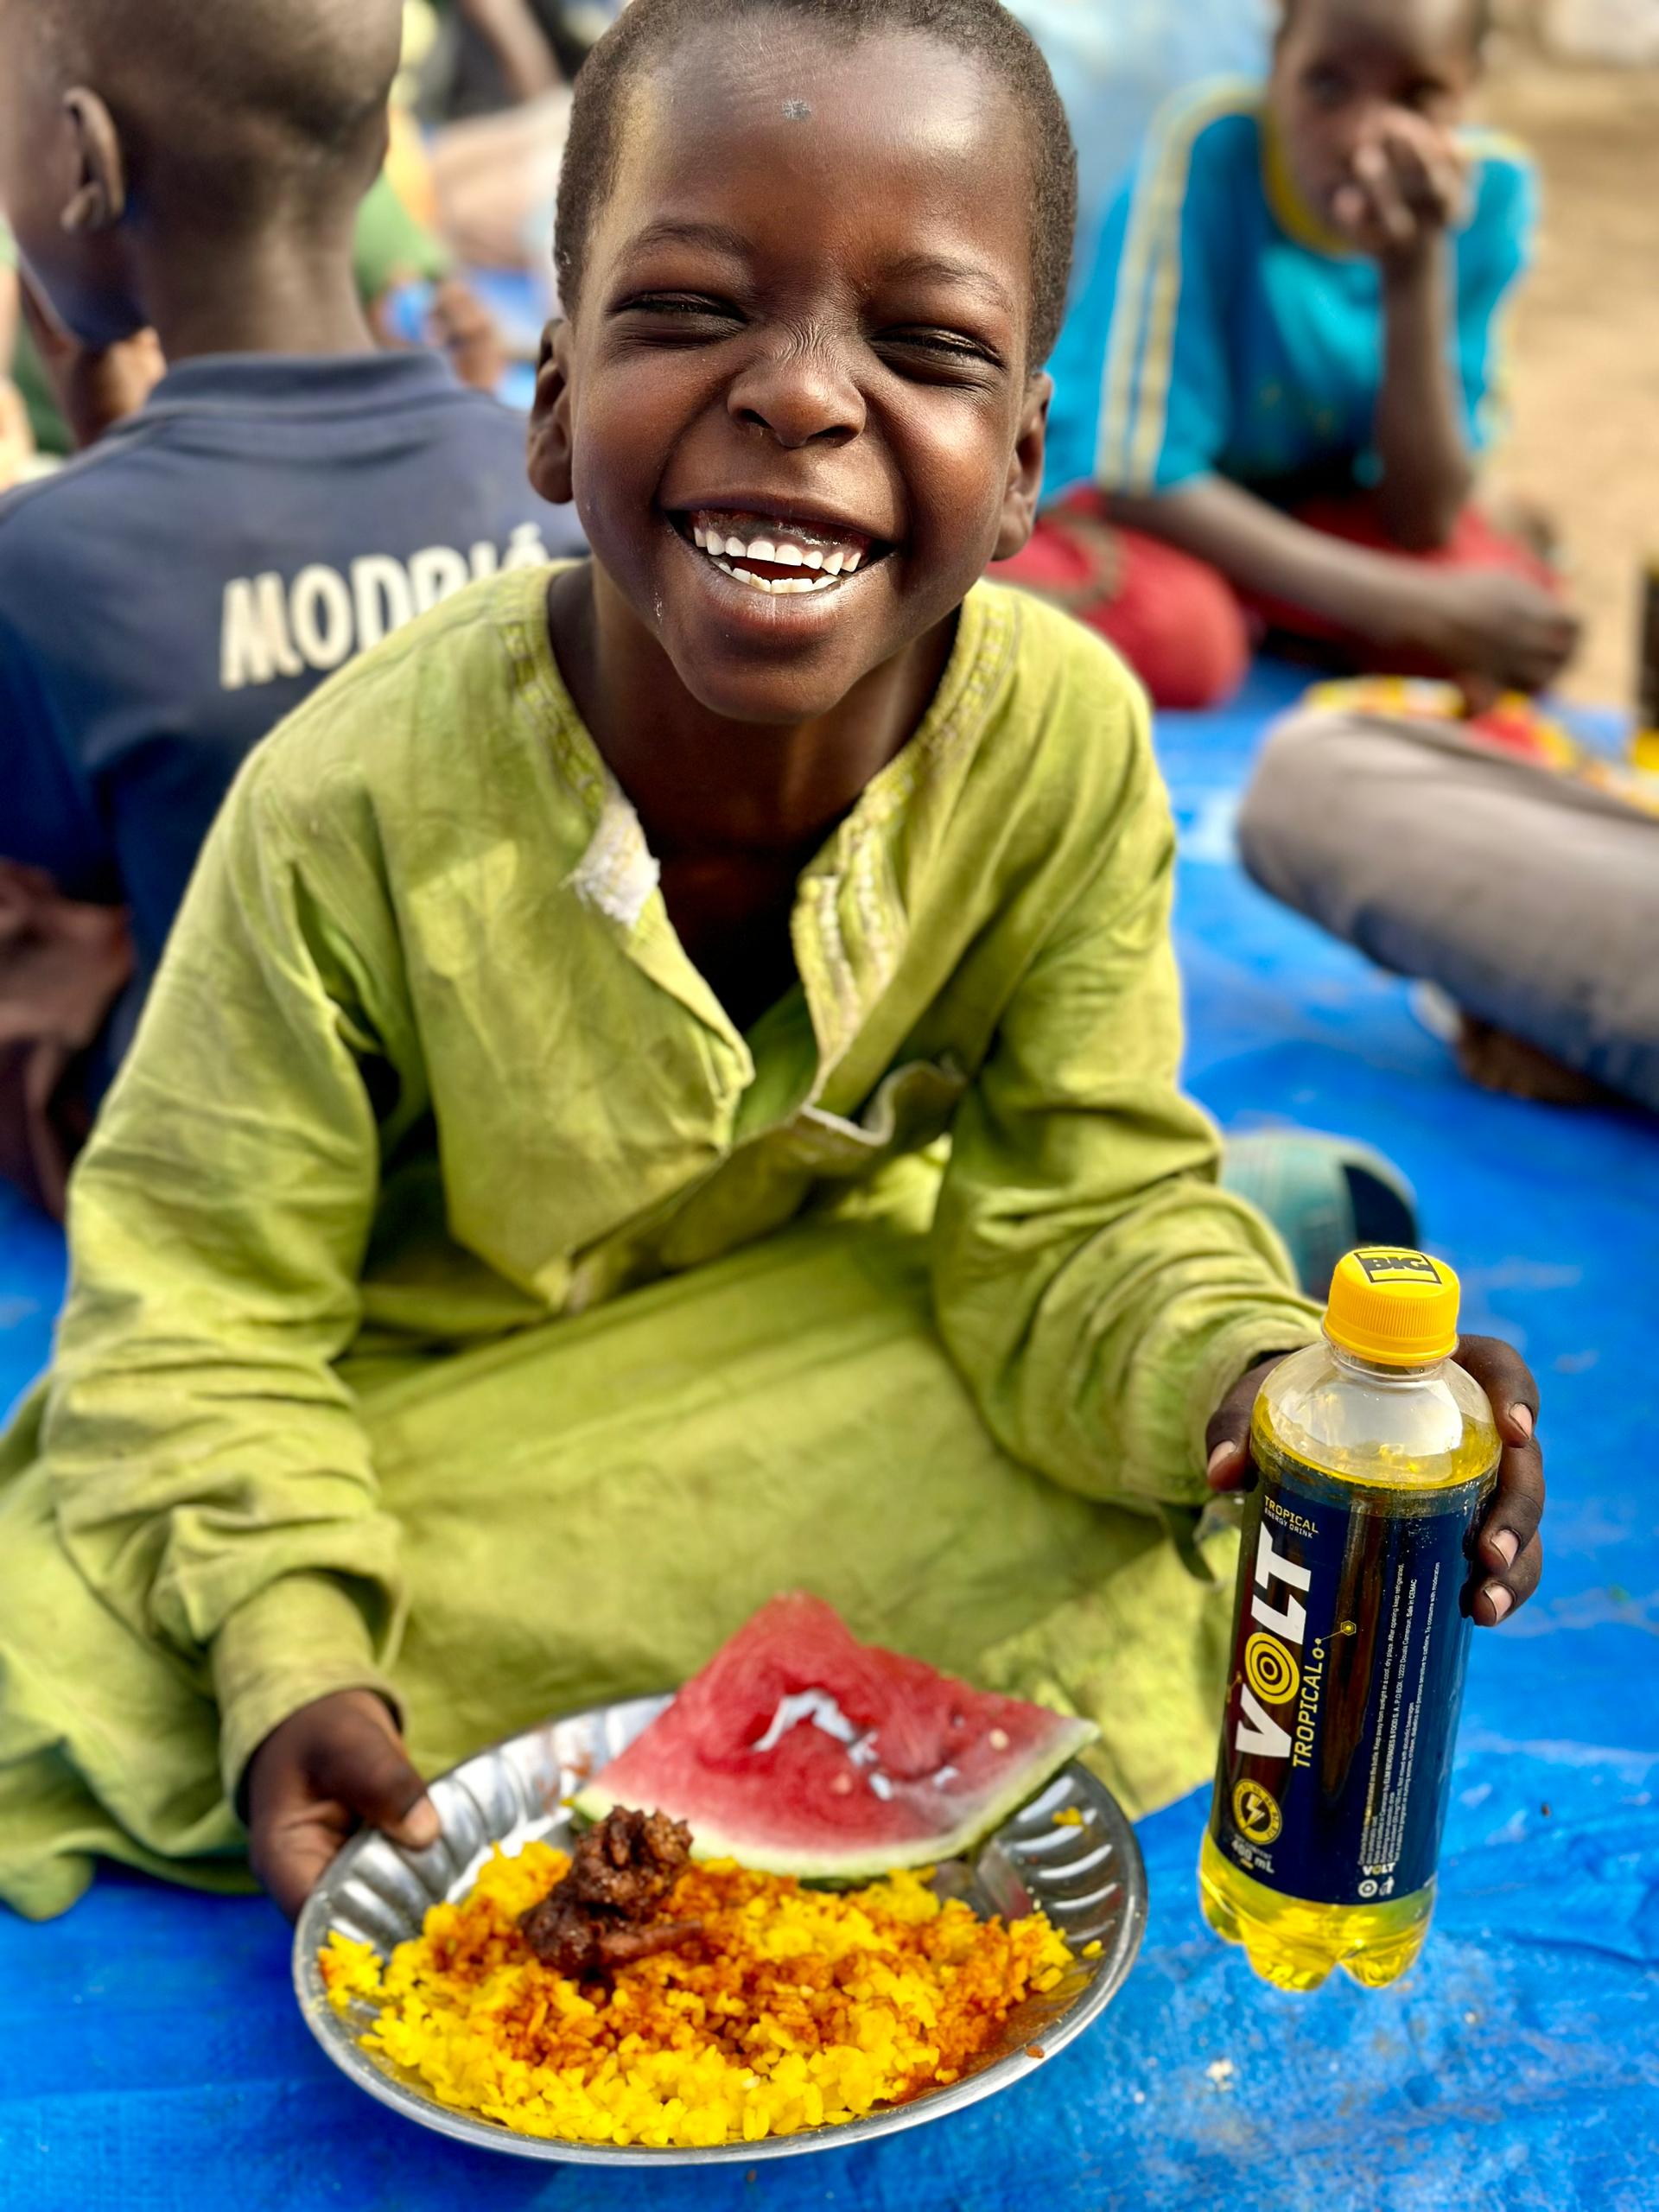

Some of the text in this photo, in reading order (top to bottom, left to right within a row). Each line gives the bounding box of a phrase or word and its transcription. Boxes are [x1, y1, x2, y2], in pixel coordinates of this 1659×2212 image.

[1361, 1256, 1434, 1273] BIG
[1264, 1494, 1319, 1535] TROPICAL
[1264, 1507, 1313, 1539] ENERGY DRINK
[1235, 1521, 1312, 1758] VOLT
[1292, 1662, 1323, 1768] TROPICAL
[1386, 1739, 1395, 1771] BEVERAGES
[1254, 1857, 1275, 1874] mL
[1362, 1862, 1396, 1876] VOLT
